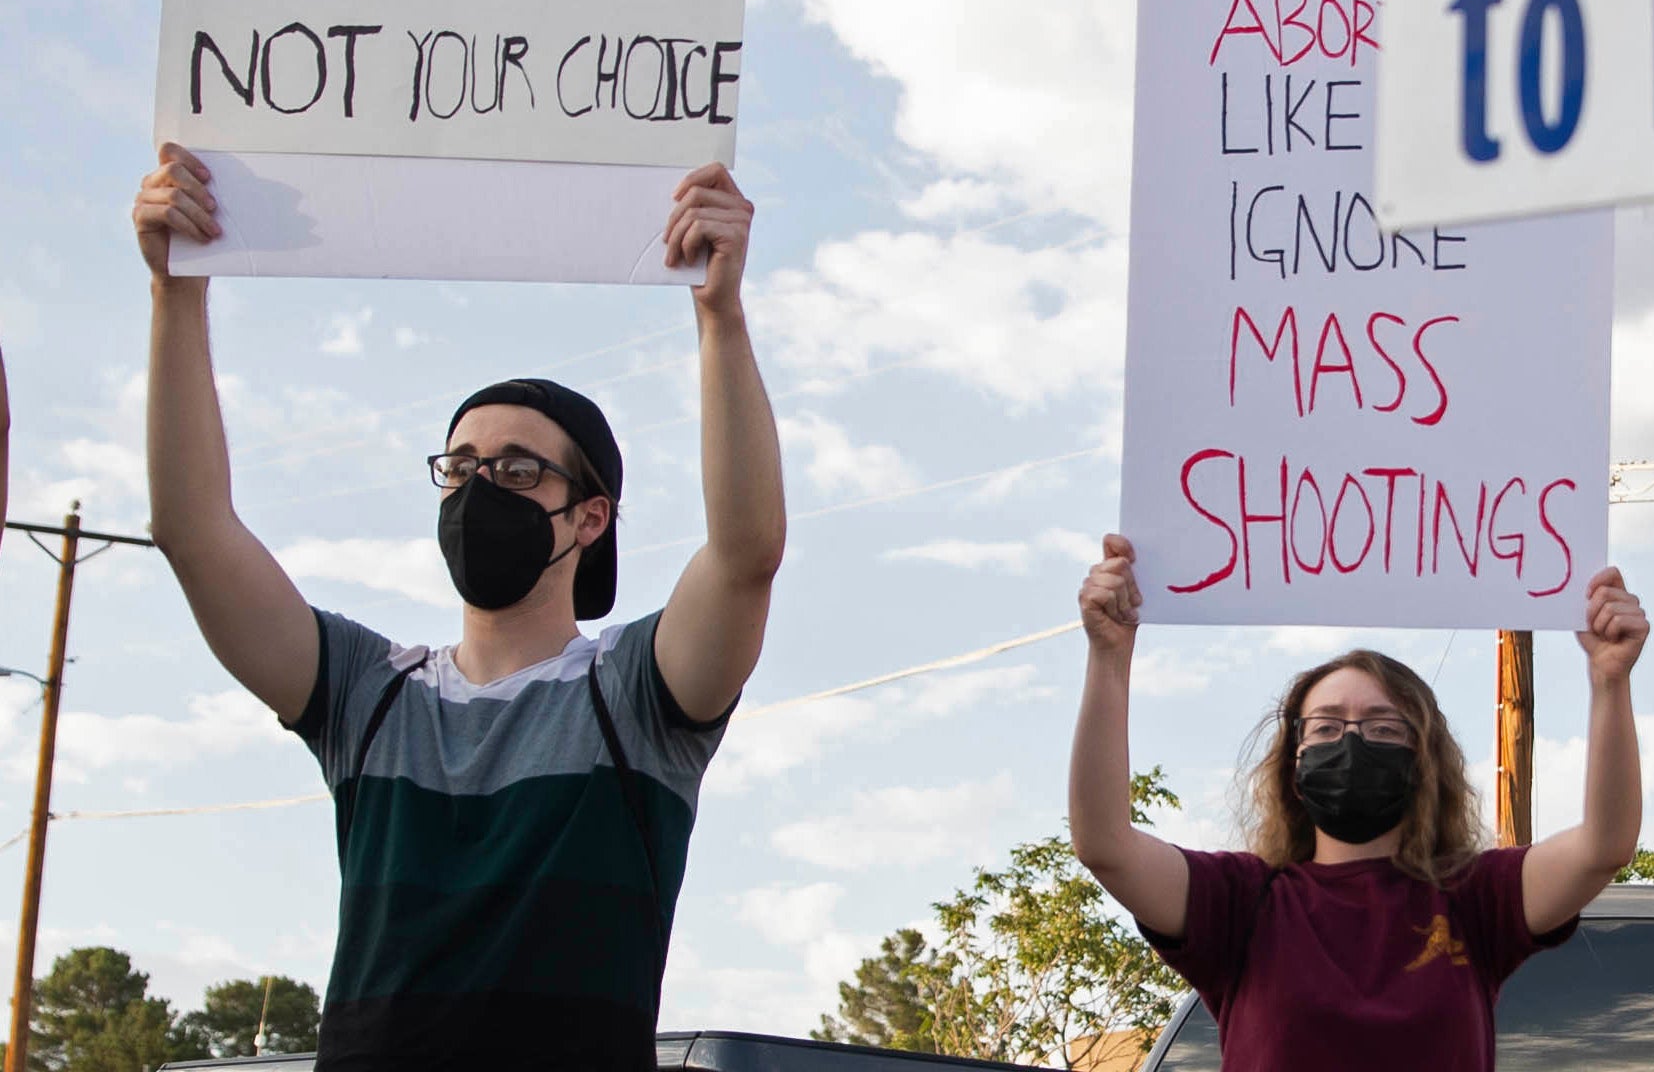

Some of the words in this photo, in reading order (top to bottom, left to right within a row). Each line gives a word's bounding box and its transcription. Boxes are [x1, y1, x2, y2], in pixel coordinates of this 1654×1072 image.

[190, 22, 383, 118] NOT
[407, 30, 535, 122] YOUR
[557, 34, 743, 125] CHOICE
[1222, 72, 1363, 155] LIKE
[1230, 307, 1459, 426] MASS
[1167, 449, 1575, 598] SHOOTINGS
